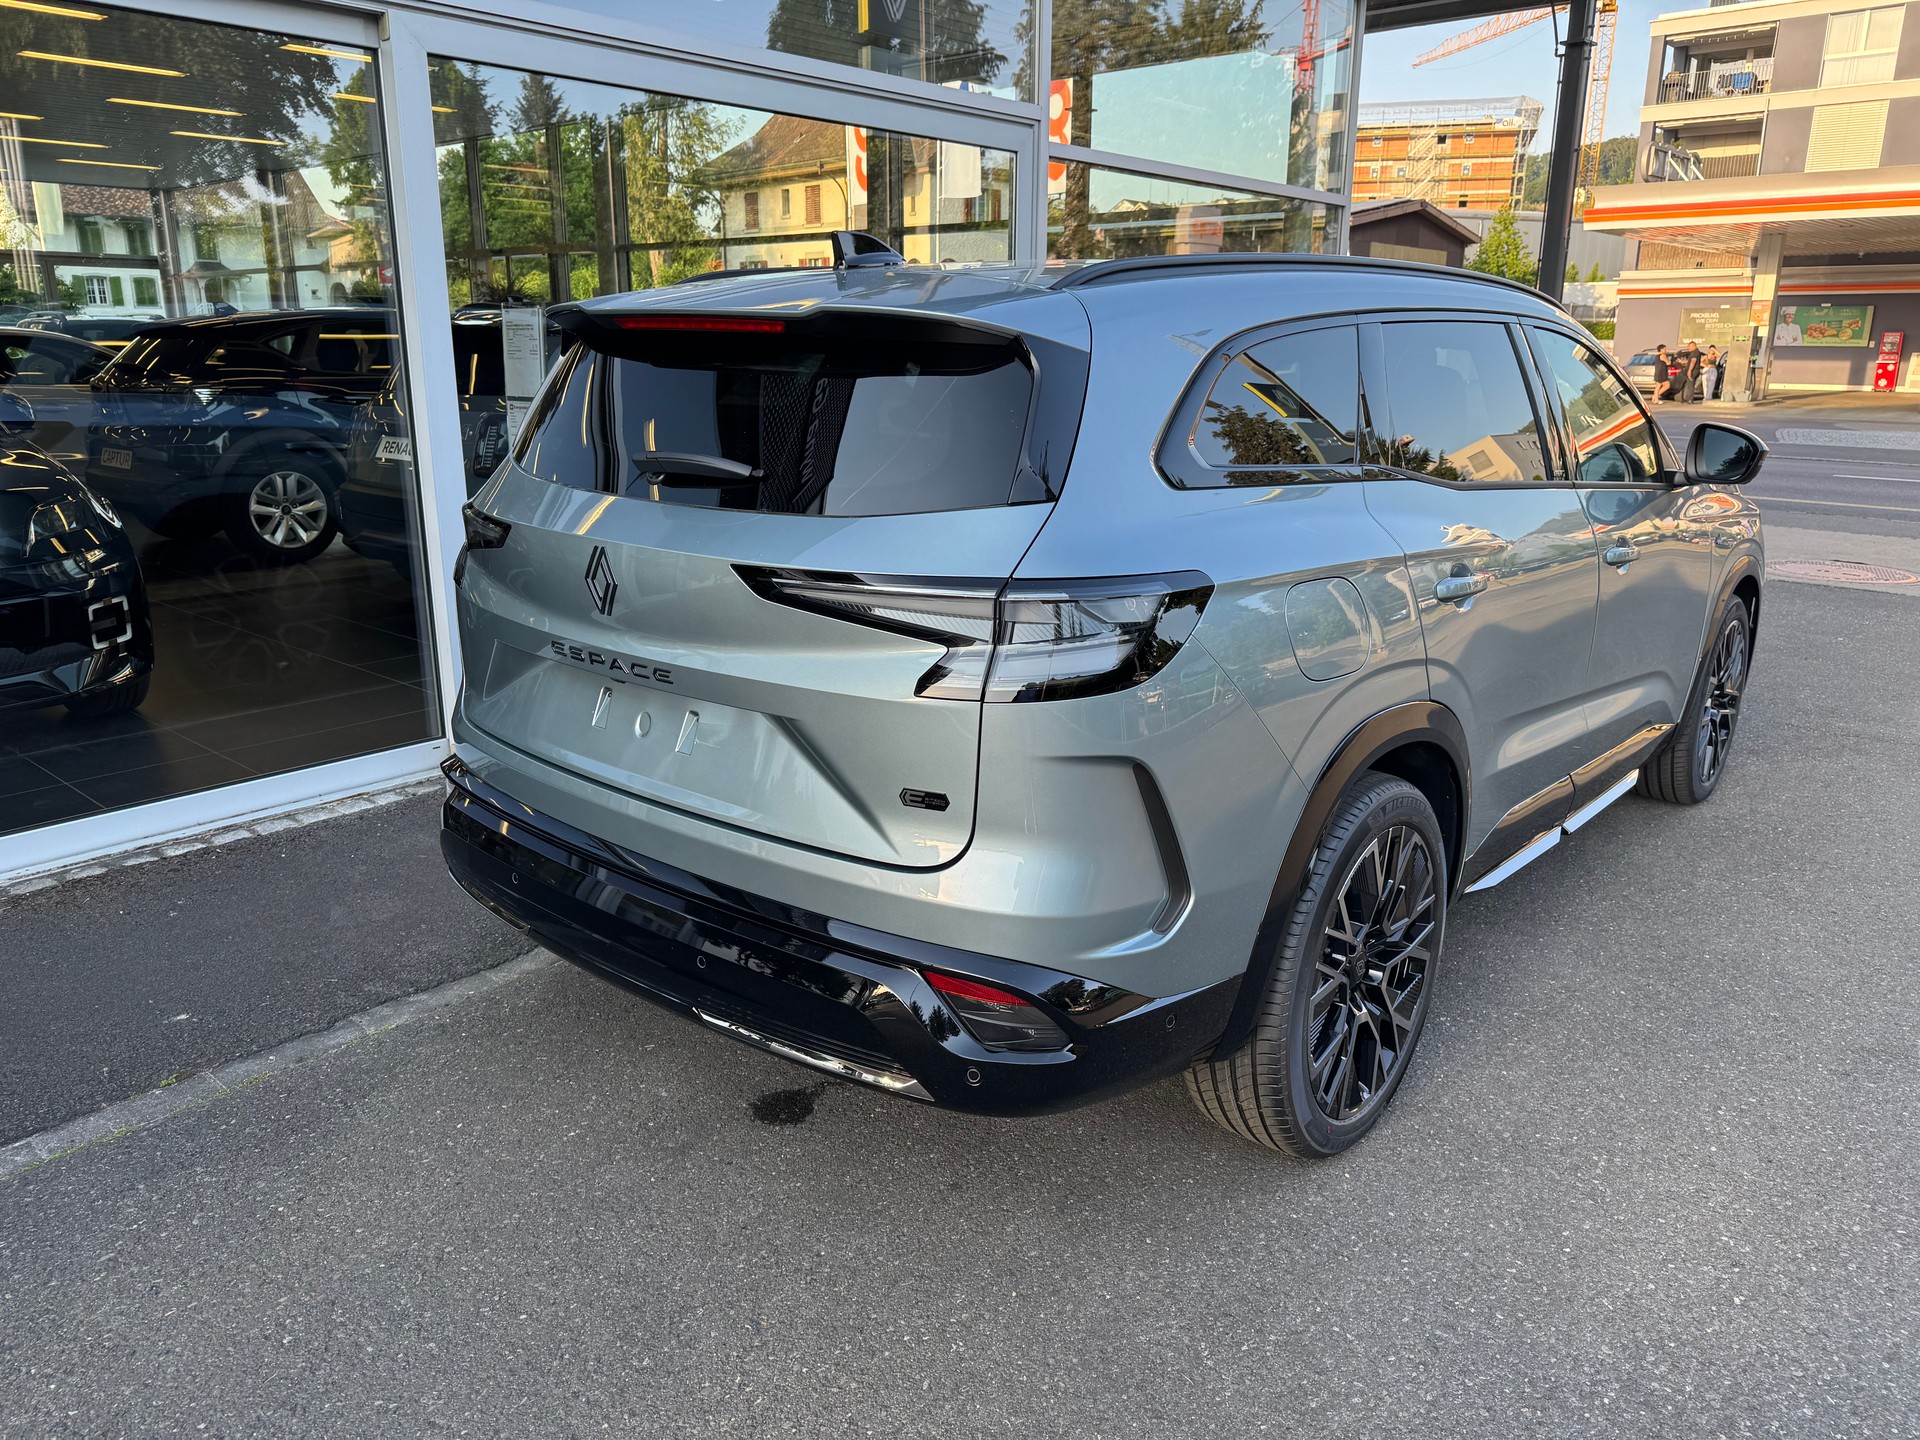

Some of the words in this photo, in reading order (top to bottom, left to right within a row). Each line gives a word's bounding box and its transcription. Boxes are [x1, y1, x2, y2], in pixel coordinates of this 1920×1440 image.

[102, 449, 131, 468] CAPTUR
[550, 640, 674, 685] ESPACE
[1385, 797, 1428, 815] MICHELIN
